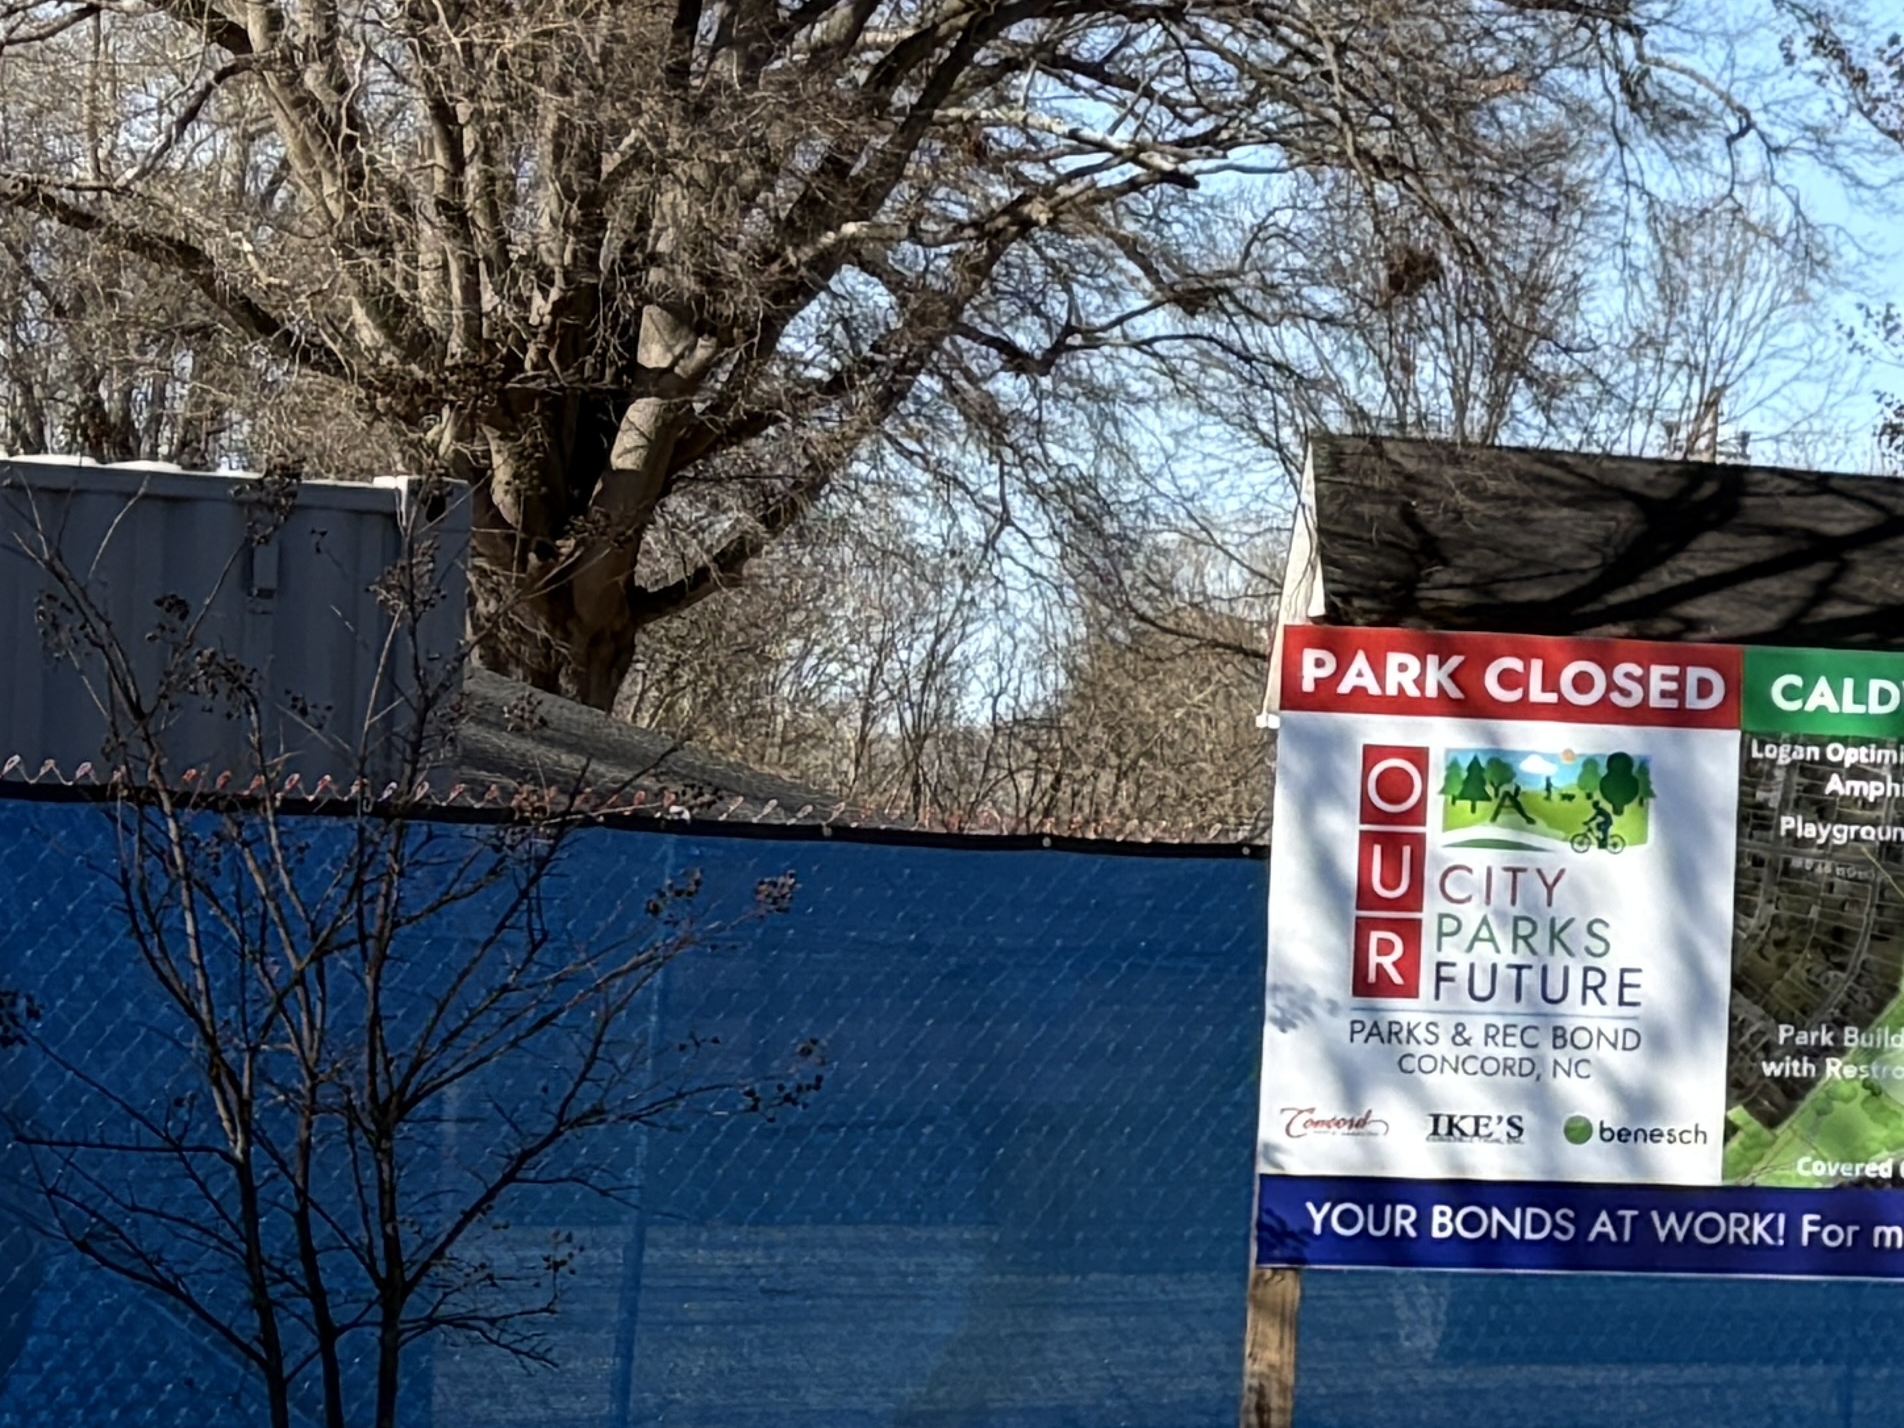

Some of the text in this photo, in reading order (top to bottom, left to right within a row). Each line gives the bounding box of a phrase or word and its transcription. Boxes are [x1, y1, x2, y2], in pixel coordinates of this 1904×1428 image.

[1302, 649, 1725, 710] PARK CLOSED
[1751, 740, 1820, 766] Logan
[1439, 864, 1566, 908] CITY
[1436, 913, 1611, 958] PARKS
[1434, 962, 1643, 1007] FUTURE
[1349, 1019, 1642, 1052] PARKS & REC BOND
[1778, 1024, 1834, 1047] Park
[1398, 1052, 1592, 1081] CONCORD, NC
[1761, 1057, 1816, 1078] with
[1427, 1113, 1525, 1139] IKE'S
[1599, 1121, 1708, 1145] benesch
[1796, 1156, 1893, 1180] Covered
[1305, 1201, 1417, 1239] YOUR
[1431, 1204, 1575, 1243] BONDS
[1588, 1209, 1639, 1244] AT
[1651, 1210, 1785, 1247] WORK!
[1801, 1214, 1860, 1248] For
